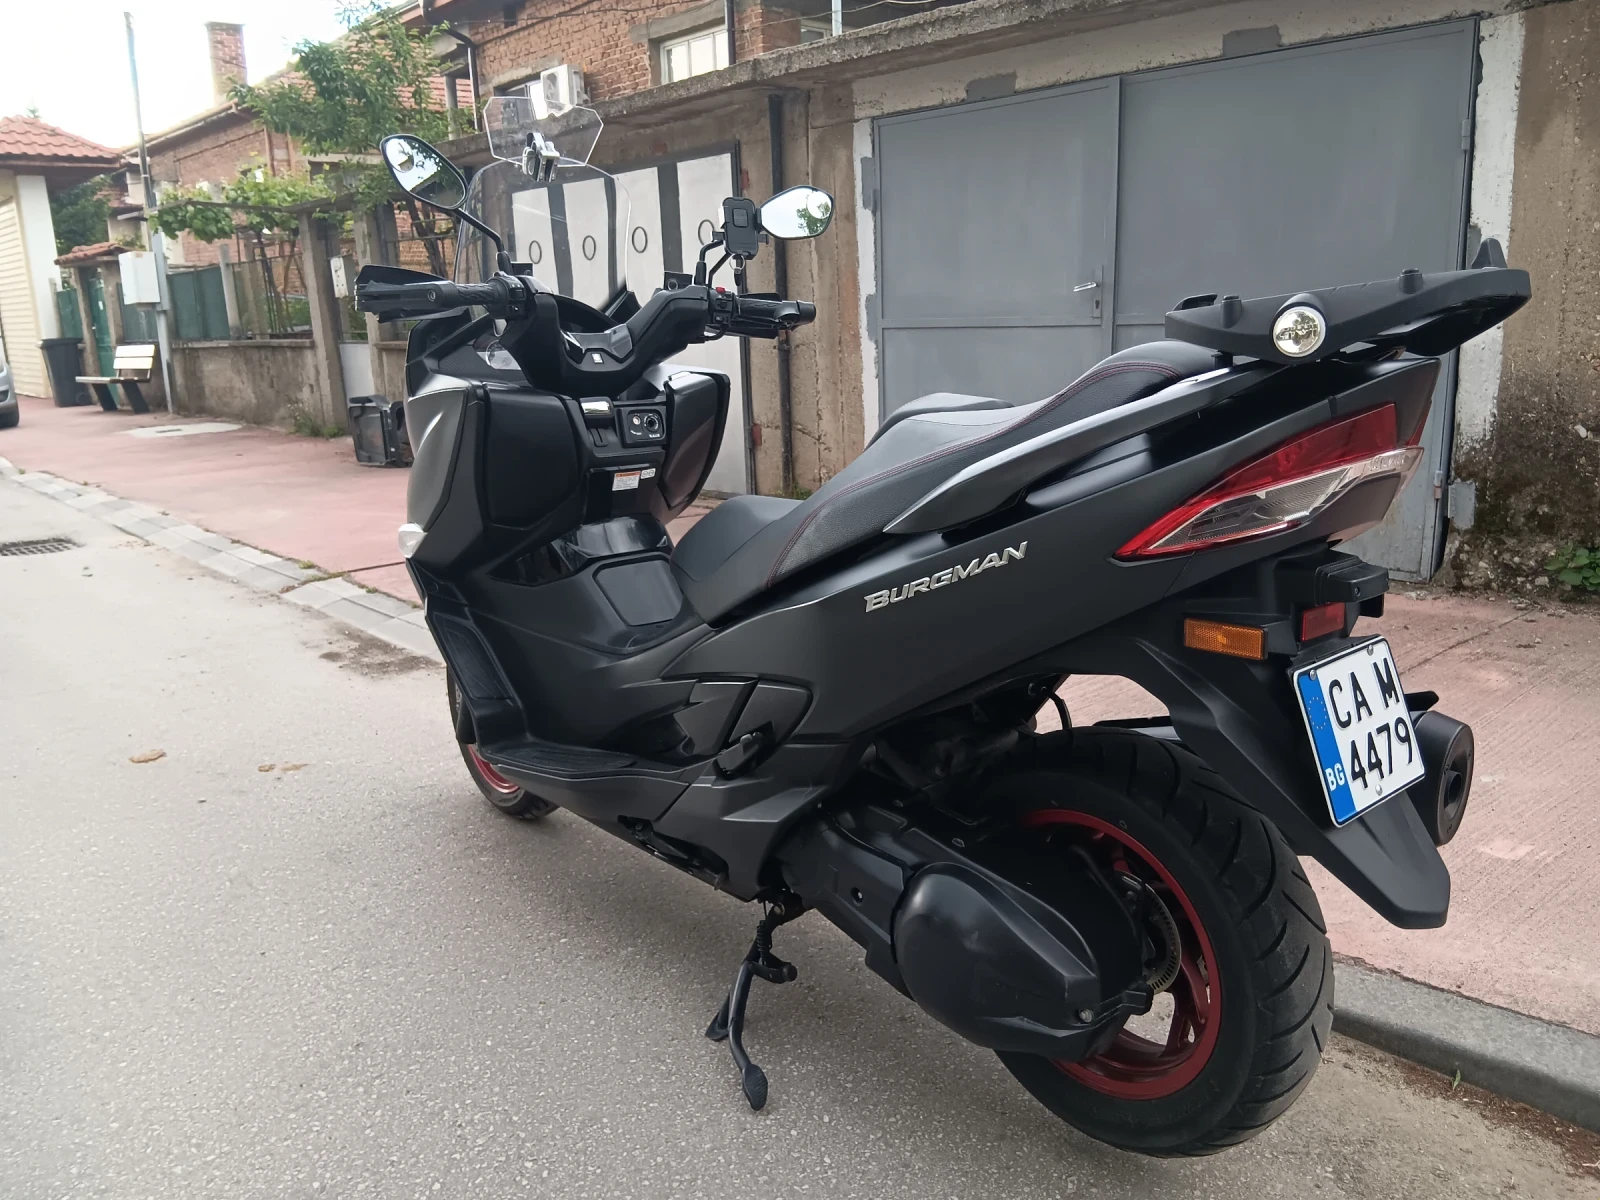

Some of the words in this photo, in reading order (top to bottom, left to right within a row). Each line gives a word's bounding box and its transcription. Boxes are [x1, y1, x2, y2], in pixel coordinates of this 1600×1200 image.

[864, 540, 1028, 613] BURGMAN
[1328, 671, 1373, 729] CA
[1372, 657, 1400, 709] M
[1325, 762, 1345, 792] BG
[1350, 716, 1413, 789] 4479
